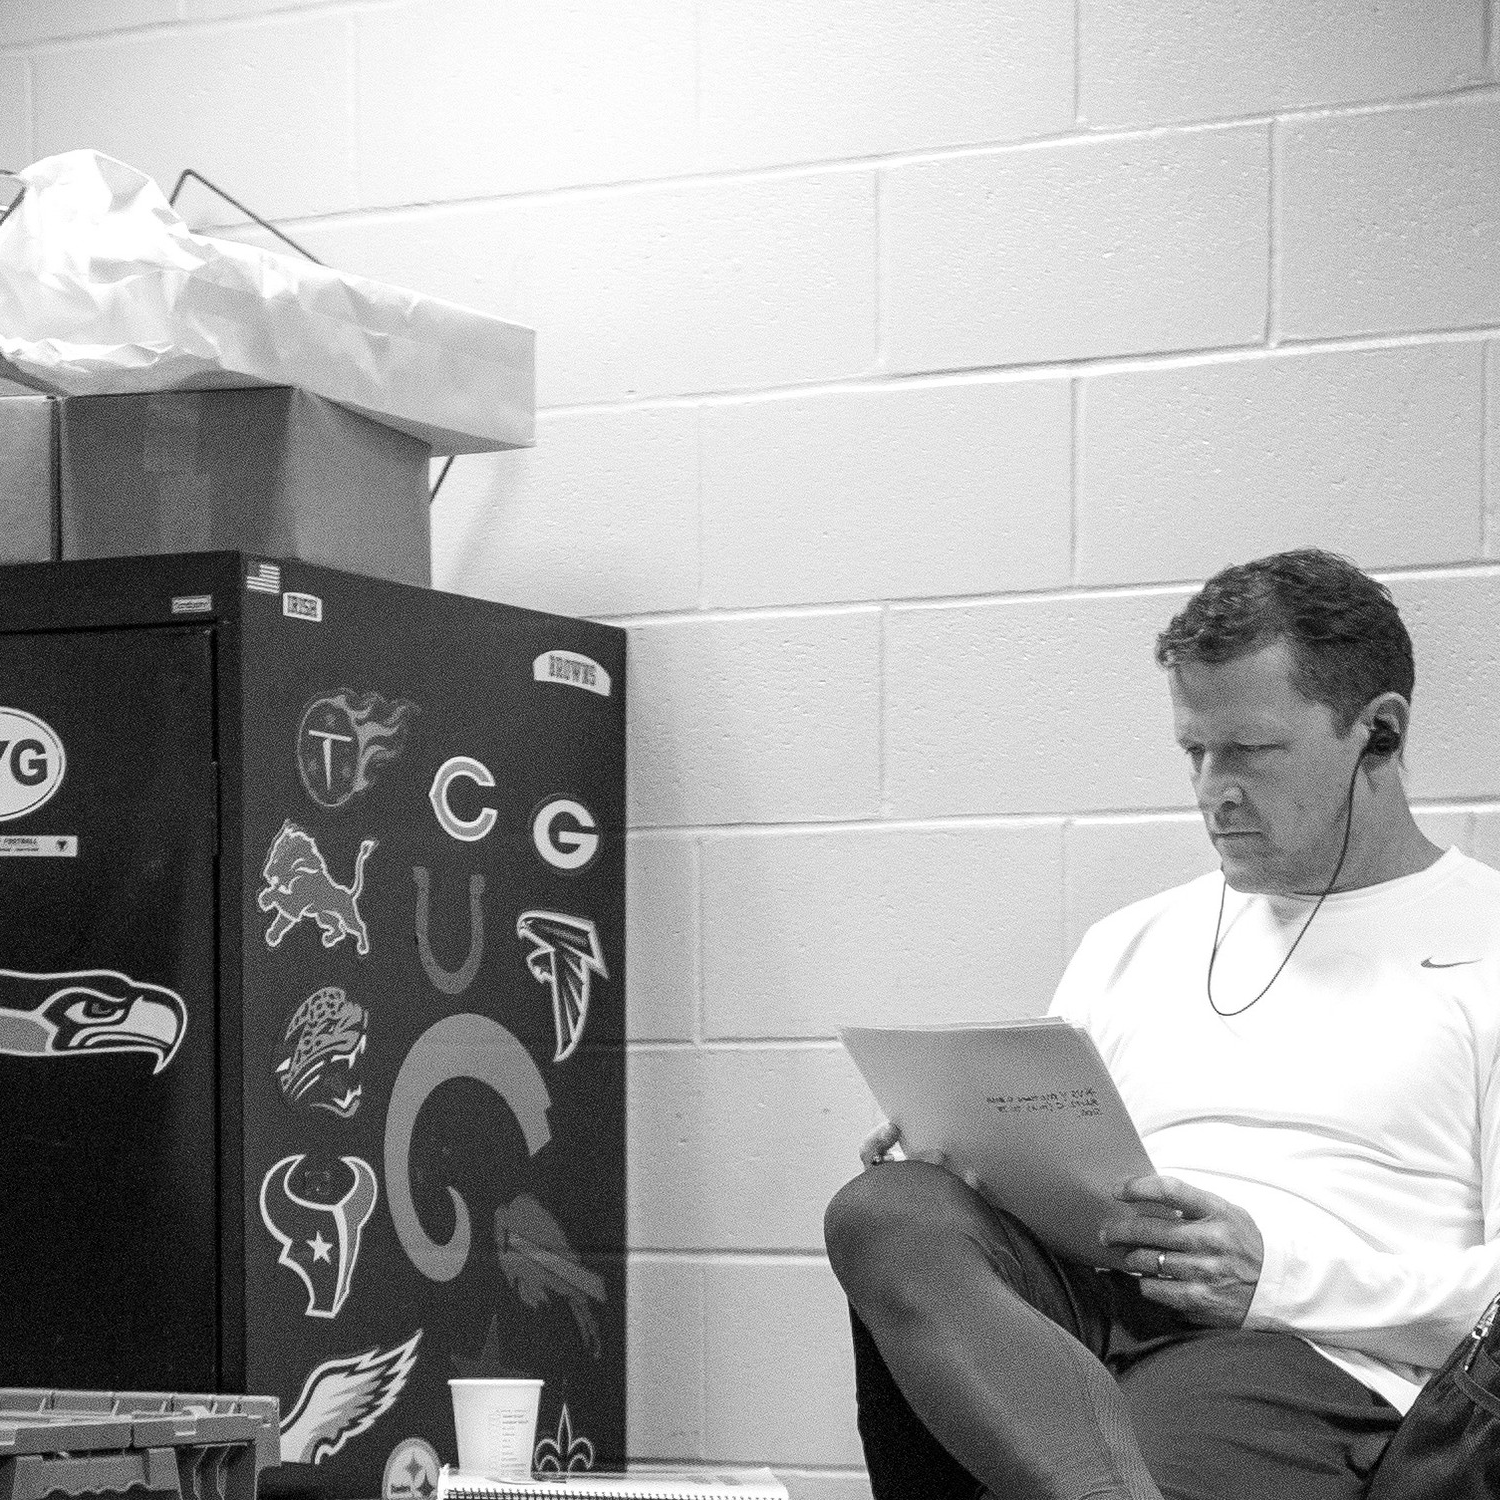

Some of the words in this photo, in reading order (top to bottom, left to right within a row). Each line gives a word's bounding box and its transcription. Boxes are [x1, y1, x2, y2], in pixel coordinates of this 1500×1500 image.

[549, 654, 596, 686] BROWNS
[429, 756, 498, 842] C
[533, 800, 599, 869] G
